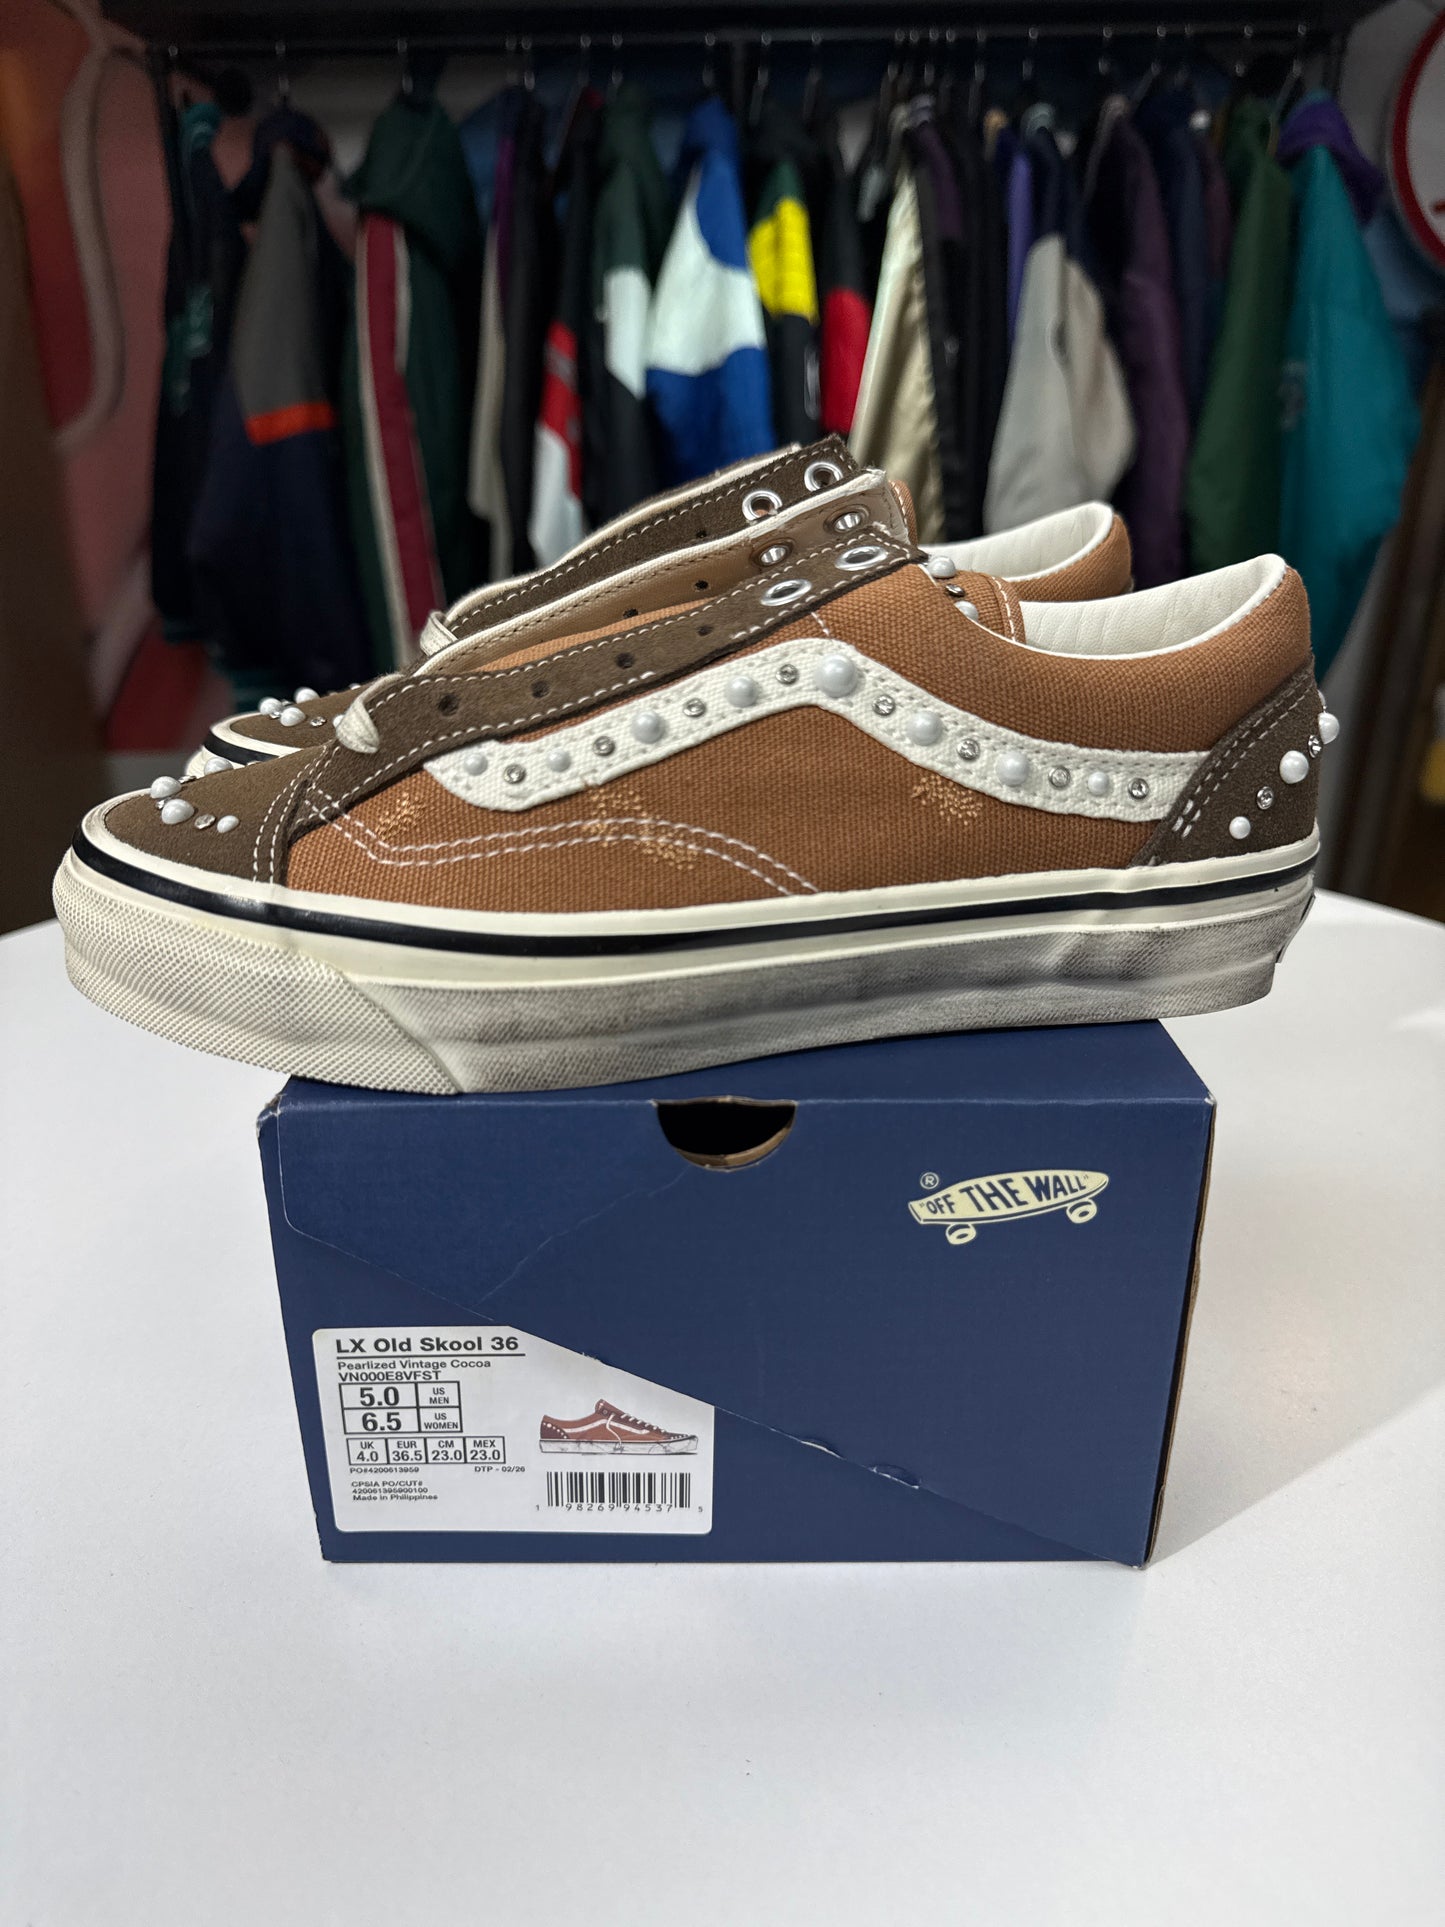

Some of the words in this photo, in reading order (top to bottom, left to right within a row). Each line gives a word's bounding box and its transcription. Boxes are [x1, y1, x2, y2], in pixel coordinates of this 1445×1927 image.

[959, 1178, 1029, 1212] THE
[336, 1338, 366, 1353] LX
[373, 1337, 412, 1352] Old
[419, 1336, 483, 1352] Skool
[490, 1336, 519, 1351] 36
[338, 1361, 397, 1371] Pearlized
[400, 1360, 447, 1371] Vintage
[450, 1359, 491, 1369] Cocoa
[338, 1370, 442, 1382] VN000E8VFST
[360, 1386, 400, 1407] 5.0
[432, 1387, 446, 1395] US
[429, 1396, 450, 1404] MEN
[361, 1412, 402, 1431] 6.5
[360, 1441, 375, 1449] UK
[396, 1440, 417, 1449] EUR
[438, 1440, 455, 1448] CM
[473, 1439, 496, 1448] MEX
[356, 1451, 379, 1462] 4.0
[392, 1450, 423, 1462] 36.5
[431, 1450, 463, 1461] 23.0
[470, 1449, 500, 1461] 23.0
